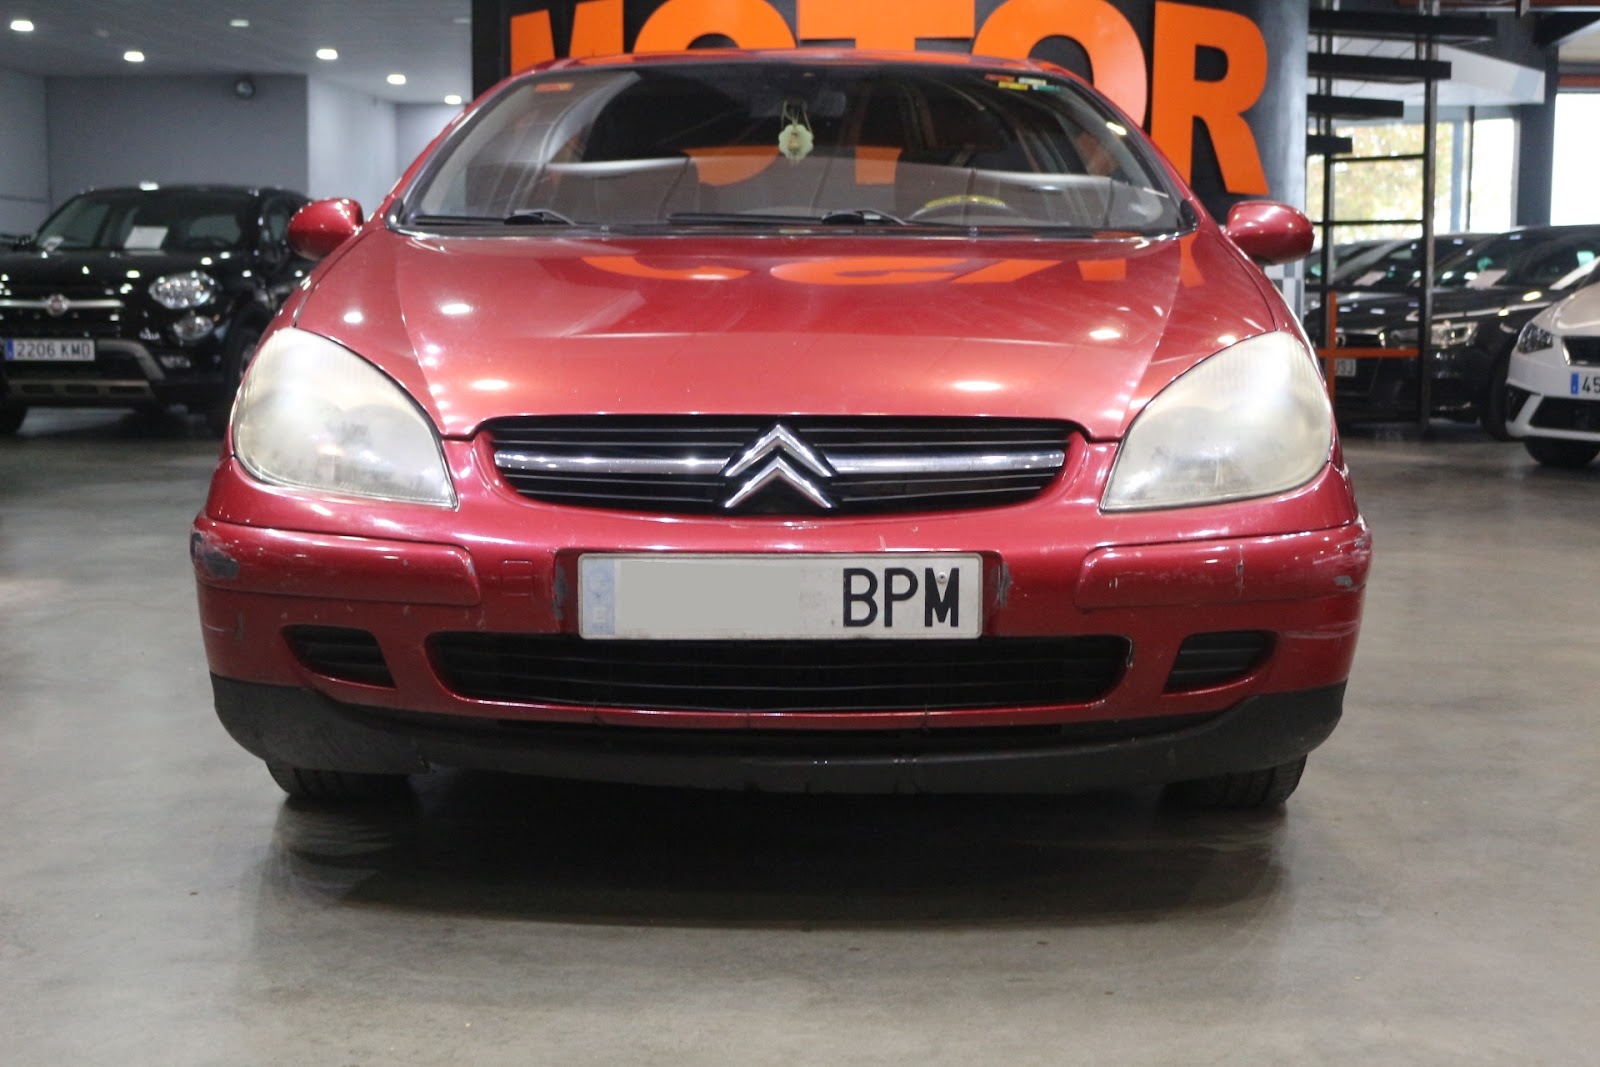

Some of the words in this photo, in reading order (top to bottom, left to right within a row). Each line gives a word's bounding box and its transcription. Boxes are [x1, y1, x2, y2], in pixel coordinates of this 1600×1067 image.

[16, 342, 55, 358] 2206
[61, 343, 91, 358] KMD
[843, 567, 959, 628] BPM
